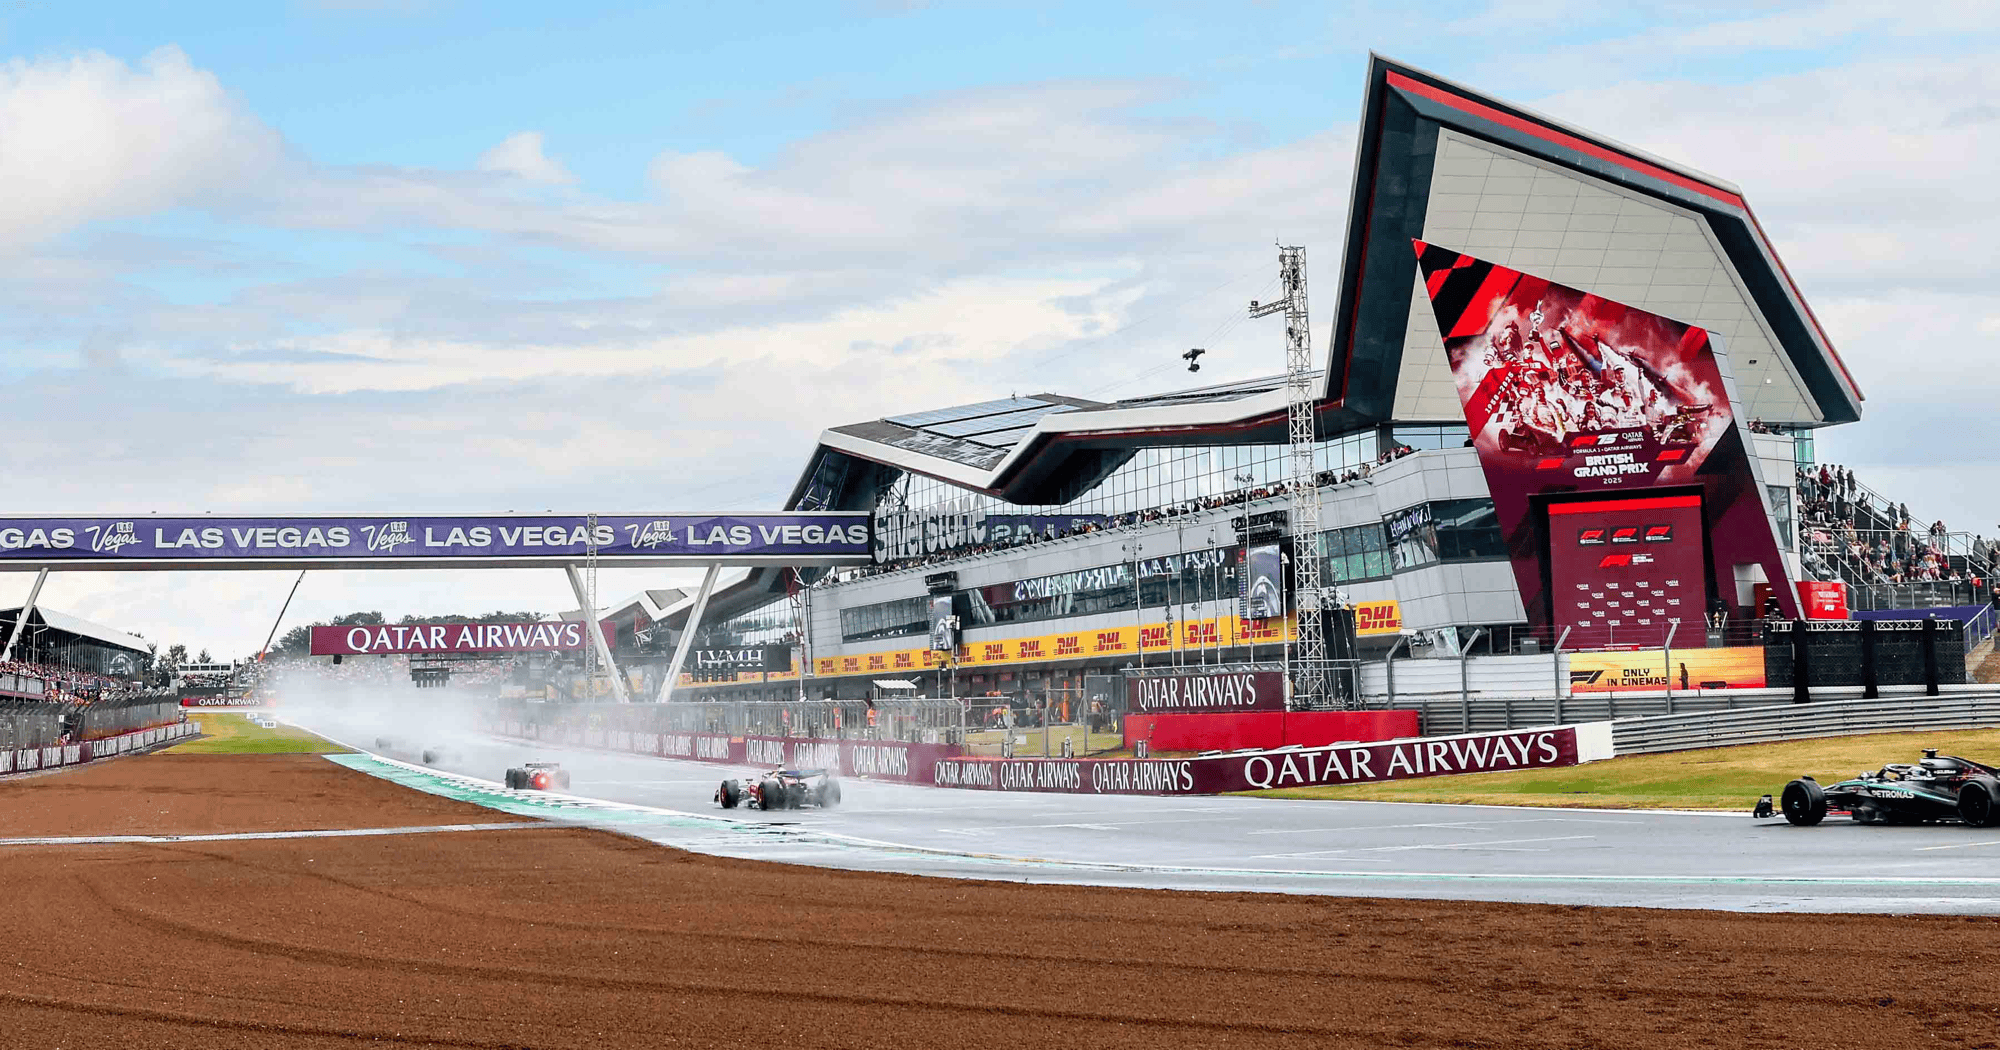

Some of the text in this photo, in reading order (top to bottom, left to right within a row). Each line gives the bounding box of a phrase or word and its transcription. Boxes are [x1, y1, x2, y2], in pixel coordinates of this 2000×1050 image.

[1574, 462, 1650, 477] GRAND PRIX
[1585, 453, 1634, 466] BRITISH
[118, 523, 132, 532] LAS
[392, 523, 406, 531] LAS
[425, 526, 615, 546] LAS VEGAS
[625, 523, 678, 549] Vegas
[655, 522, 669, 530] LAS
[687, 525, 868, 545] LAS VEGAS
[85, 524, 142, 553] Vegas
[155, 527, 350, 548] LAS VEGAS
[361, 525, 415, 552] Vegas
[1359, 605, 1397, 630] DHL
[347, 624, 580, 652] QATAR AIRWAYS
[1140, 627, 1167, 647] DHL
[1188, 623, 1217, 643] DHL
[1240, 619, 1272, 639] DHL
[985, 643, 1005, 660] DHL
[1020, 640, 1042, 658] DHL
[1056, 636, 1081, 655] DHL
[1097, 632, 1121, 651] DHL
[895, 653, 912, 668] DHL
[1607, 677, 1668, 686] IN CINEMAS
[1623, 668, 1650, 677] ONLY
[227, 698, 260, 706] AIRWAYS
[1138, 674, 1257, 711] QATAR AIRWAYS
[746, 739, 785, 764] QATAR AIRWAYS
[794, 743, 839, 770] QATAR AIRWAYS
[853, 745, 908, 775] QATAR AIRWAYS
[1244, 733, 1558, 789] QATAR AIRWAYS
[935, 761, 992, 786] QATAR AIRWAYS
[1001, 762, 1080, 789] QATAR AIRWAYS
[1093, 761, 1193, 792] QATAR AIRWAYS
[1871, 790, 1914, 799] PETRONAS
